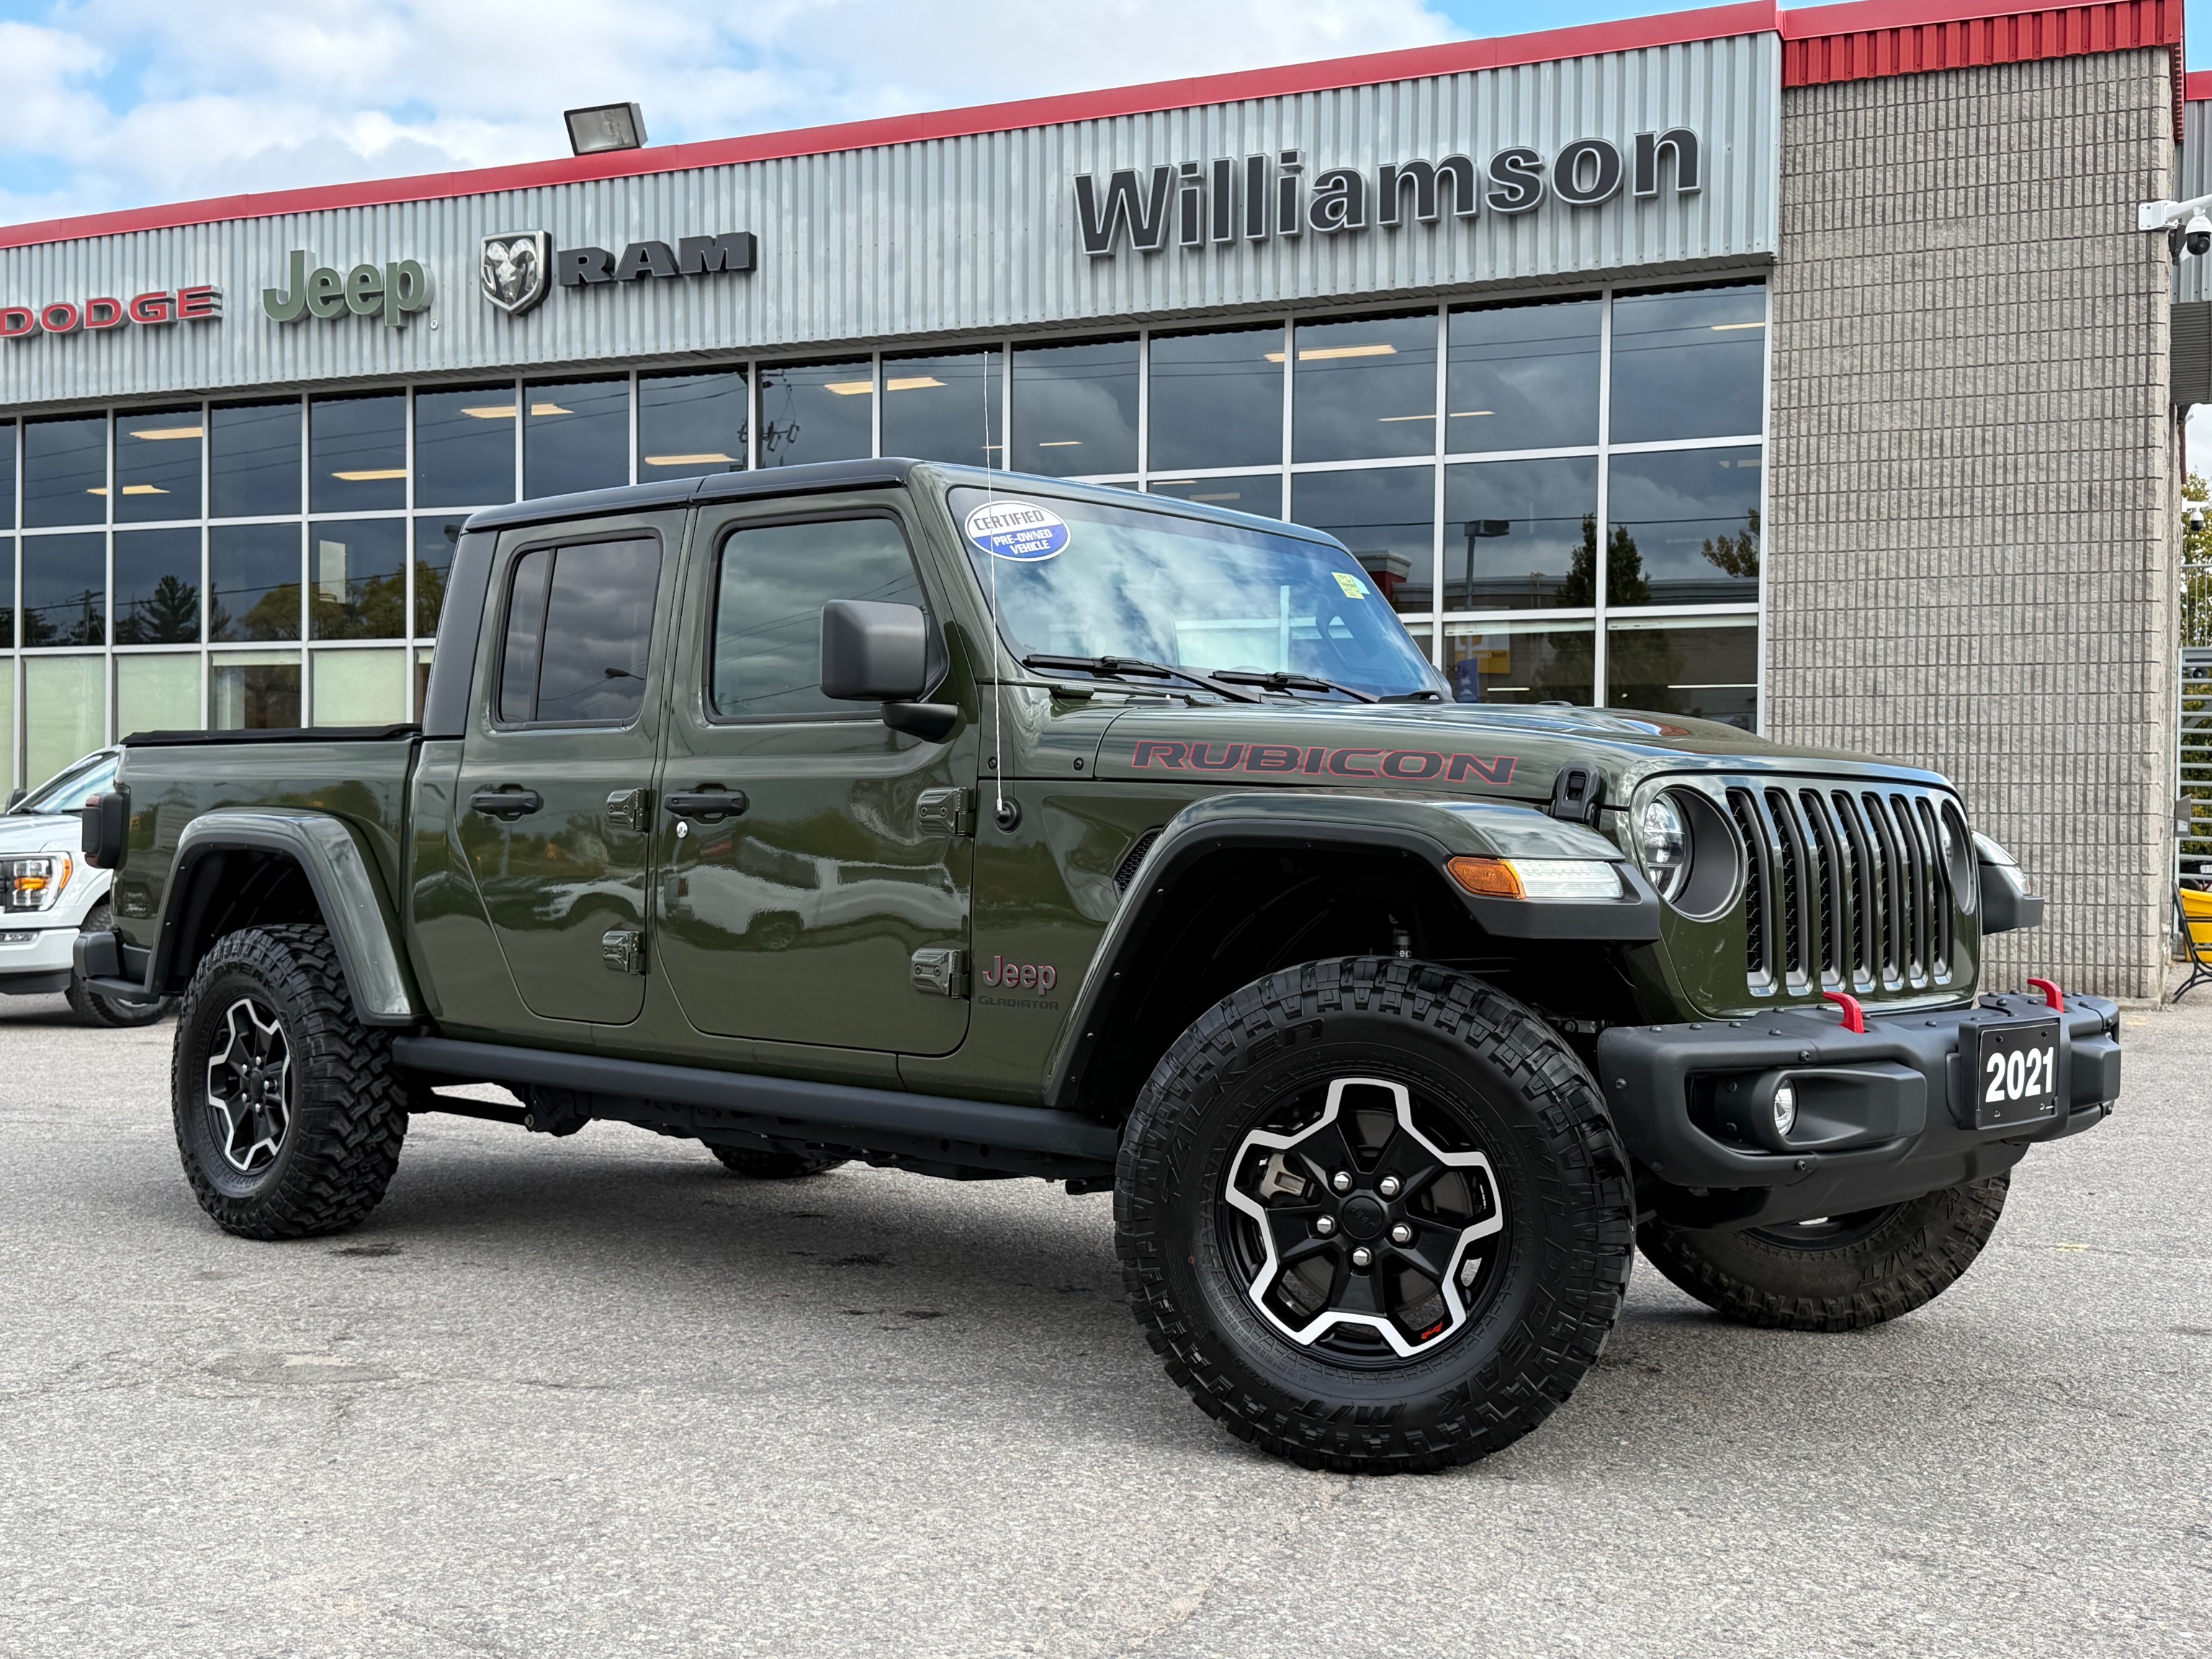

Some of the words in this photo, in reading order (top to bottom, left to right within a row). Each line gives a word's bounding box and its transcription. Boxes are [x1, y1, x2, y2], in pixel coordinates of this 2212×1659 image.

[1073, 126, 1702, 257] Williamson
[557, 231, 757, 287] RAM
[0, 285, 222, 338] DODGE
[263, 249, 433, 328] Jeep
[974, 510, 1045, 531] CERTIFIED
[992, 529, 1053, 547] PRE-OWNED
[1010, 539, 1051, 554] VEHICLE
[1132, 740, 1518, 785] RUBICON
[982, 956, 1058, 997] Jeep
[978, 995, 1059, 1011] GLADIATOR
[1985, 1047, 2054, 1103] 2021
[1437, 1123, 1568, 1417] WILDPEAK
